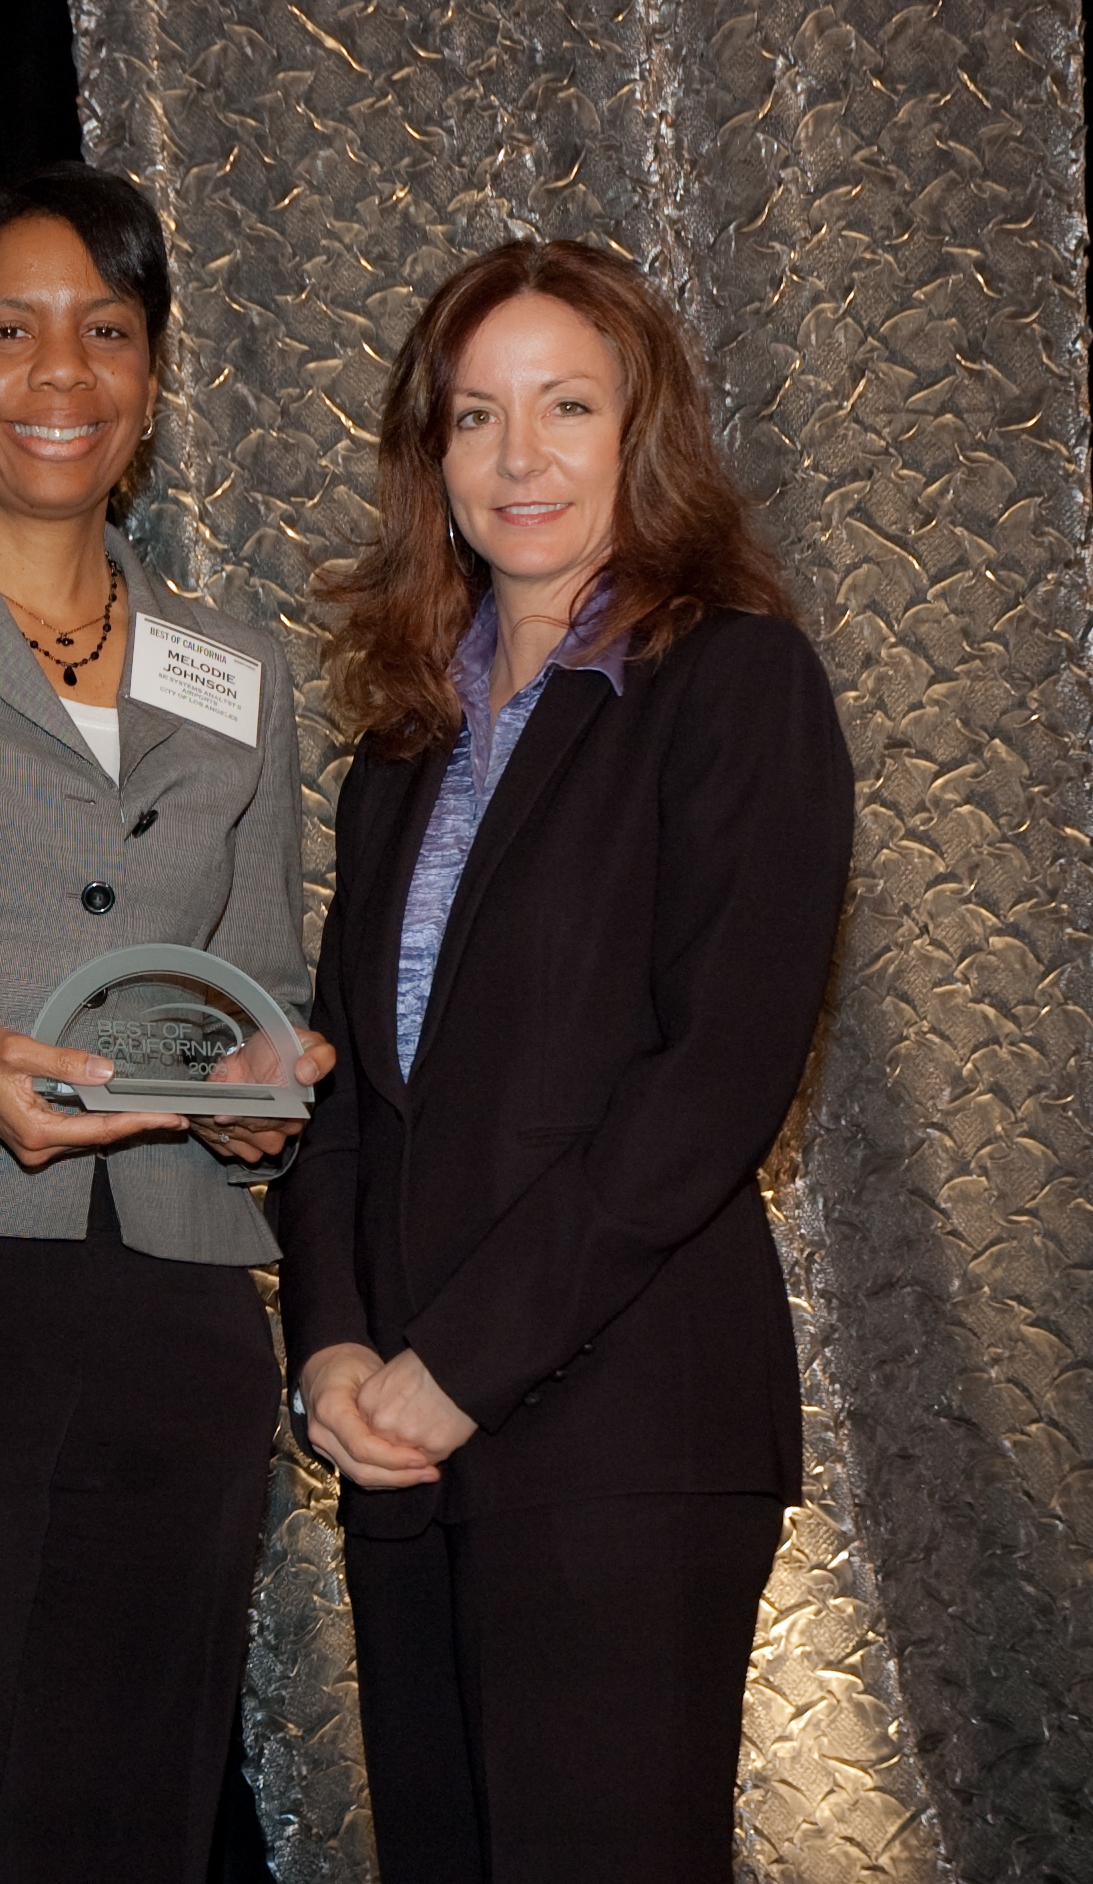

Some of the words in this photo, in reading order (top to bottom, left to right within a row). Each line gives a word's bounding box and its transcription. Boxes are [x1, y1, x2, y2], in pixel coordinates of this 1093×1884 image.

[150, 627, 169, 641] BEST
[170, 634, 181, 645] OF
[182, 639, 227, 664] CALIFORNIA
[163, 663, 237, 699] JOHNSON
[167, 649, 236, 685] MELODIE
[159, 686, 177, 697] CITY
[188, 697, 204, 707] LOS
[204, 704, 238, 722] ANGELES
[97, 1020, 156, 1038] BEST
[162, 1022, 193, 1039] OF
[97, 1036, 227, 1057] CALIFORNIA
